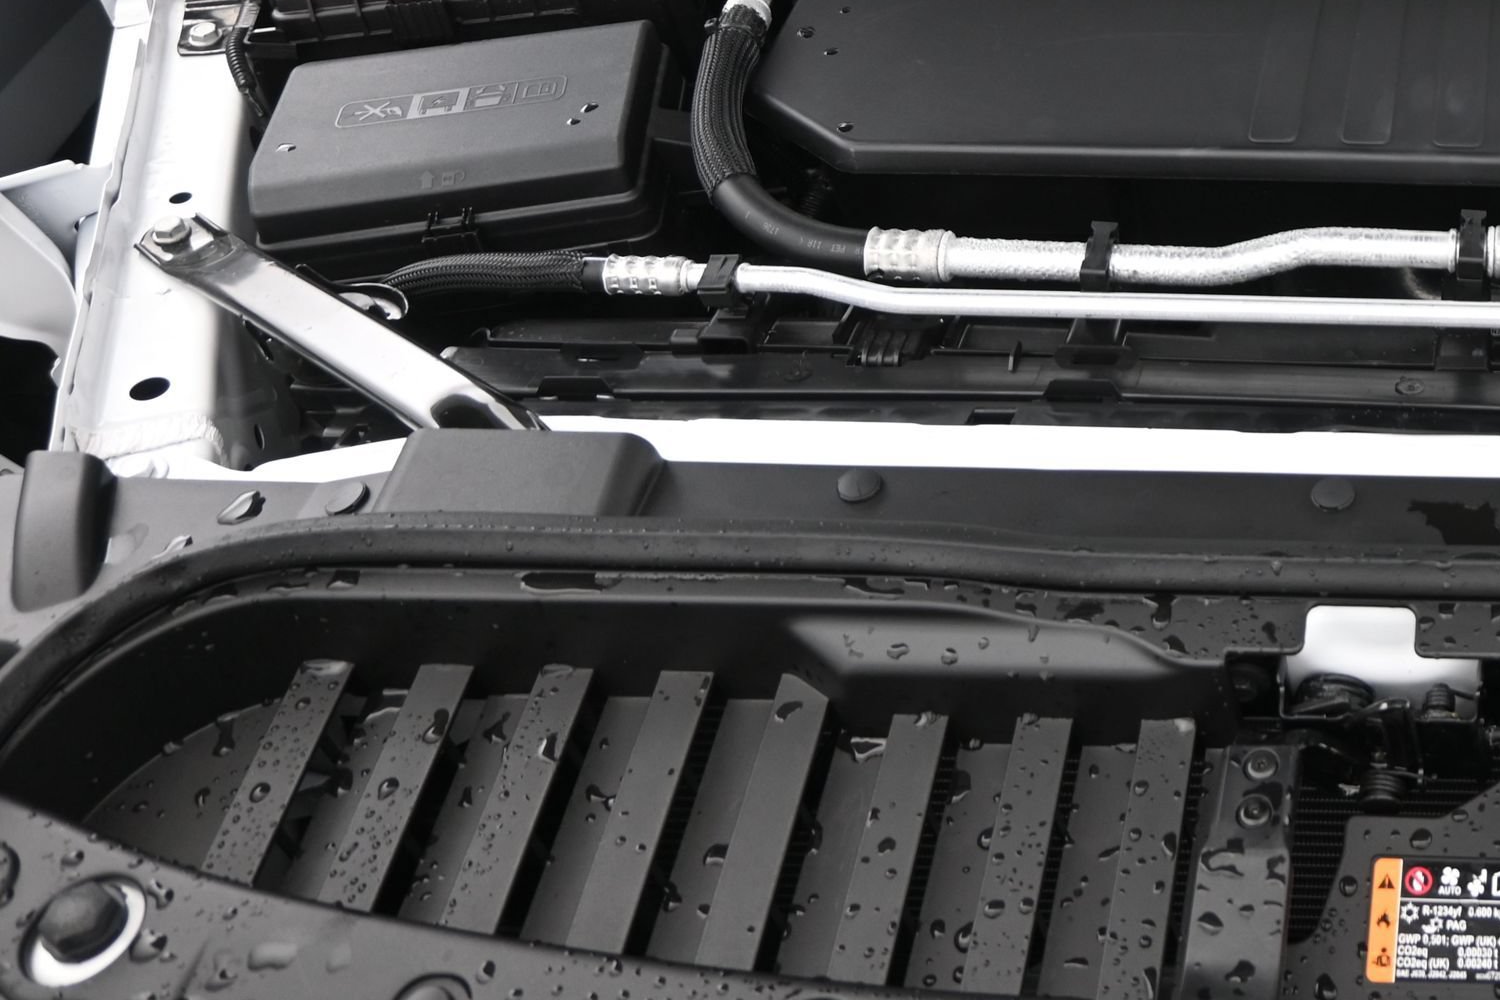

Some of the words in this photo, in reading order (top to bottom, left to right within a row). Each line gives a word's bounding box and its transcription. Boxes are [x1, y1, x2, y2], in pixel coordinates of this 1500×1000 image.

[1438, 885, 1462, 896] AUTO
[1422, 904, 1462, 919] R-1234yf
[1446, 919, 1467, 932] PAG
[1398, 933, 1421, 945] GWP
[1450, 934, 1475, 947] GWP
[1475, 935, 1497, 949] (UK)
[1397, 944, 1429, 959] CO2eq
[1396, 956, 1427, 971] CO2eq
[1428, 957, 1450, 971] (UK)
